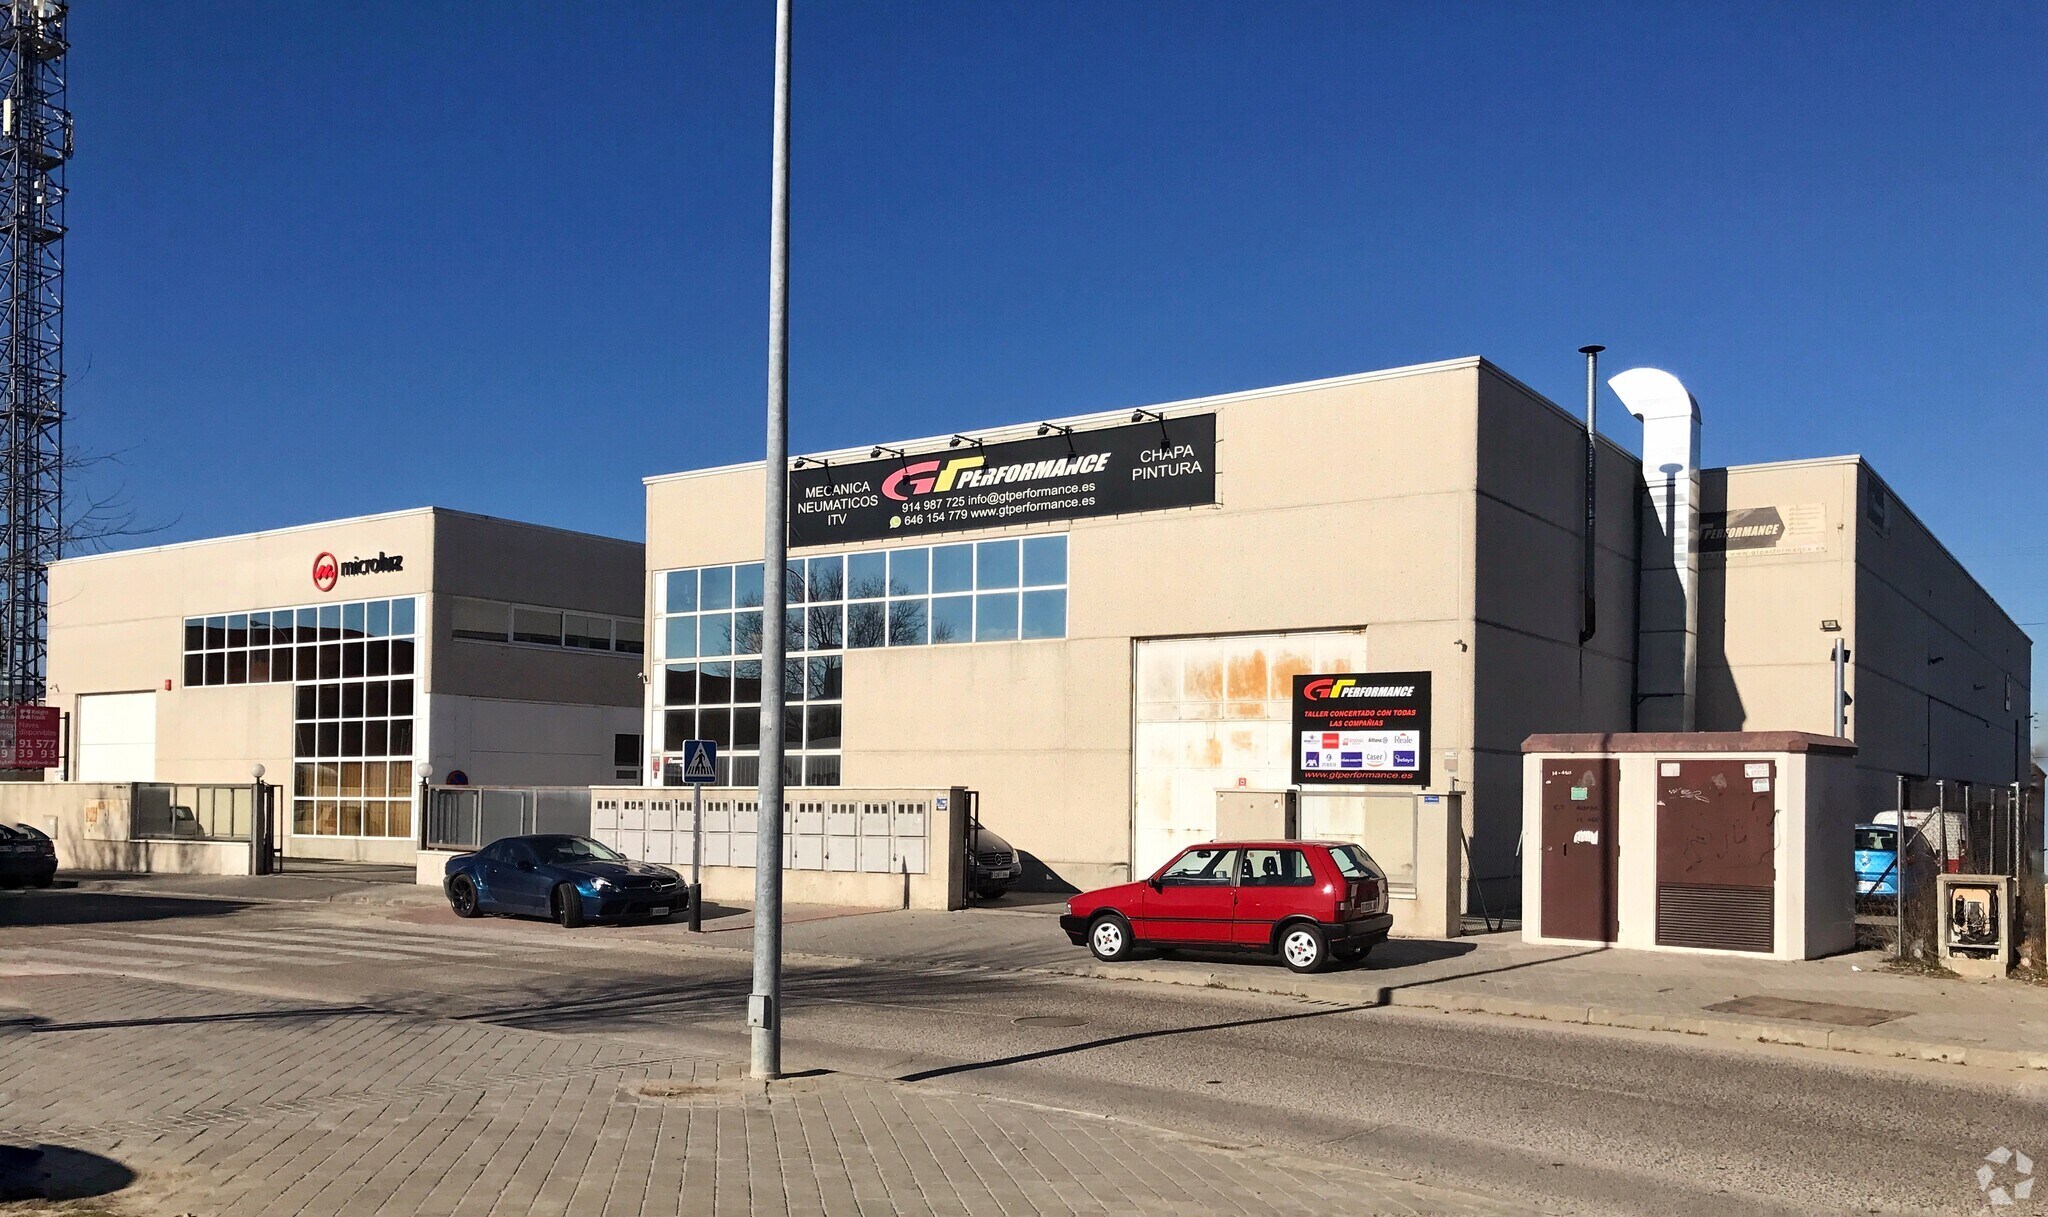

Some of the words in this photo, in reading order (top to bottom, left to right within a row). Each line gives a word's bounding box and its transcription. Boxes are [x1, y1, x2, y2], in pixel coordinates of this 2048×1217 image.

[1140, 444, 1194, 463] CHAPA
[881, 455, 986, 501] GT
[956, 452, 1112, 490] PERFORMANCE
[1132, 460, 1202, 481] PINTURA
[805, 481, 871, 498] MECANICA
[901, 502, 921, 513] 914
[923, 499, 943, 511] 987
[946, 497, 966, 508] 725
[968, 482, 1096, 506] info@gtperformance.es
[797, 495, 879, 514] NEUMATICOS
[904, 515, 924, 526] 646
[926, 512, 945, 523] 154
[948, 509, 968, 520] 779
[970, 496, 1096, 519] www.gtperformance.es
[828, 513, 847, 526] ITV
[1704, 524, 1780, 539] PERFORMANCE
[1303, 678, 1356, 701] GT
[1340, 686, 1415, 698] PERFORMANCE
[1329, 709, 1376, 717] CONCERTADO
[1376, 709, 1392, 717] CON
[1343, 718, 1384, 727] COMPAÑIAS
[19, 739, 32, 748] 91
[36, 739, 56, 749] 577
[1304, 771, 1414, 779] www.gtperformance.es
